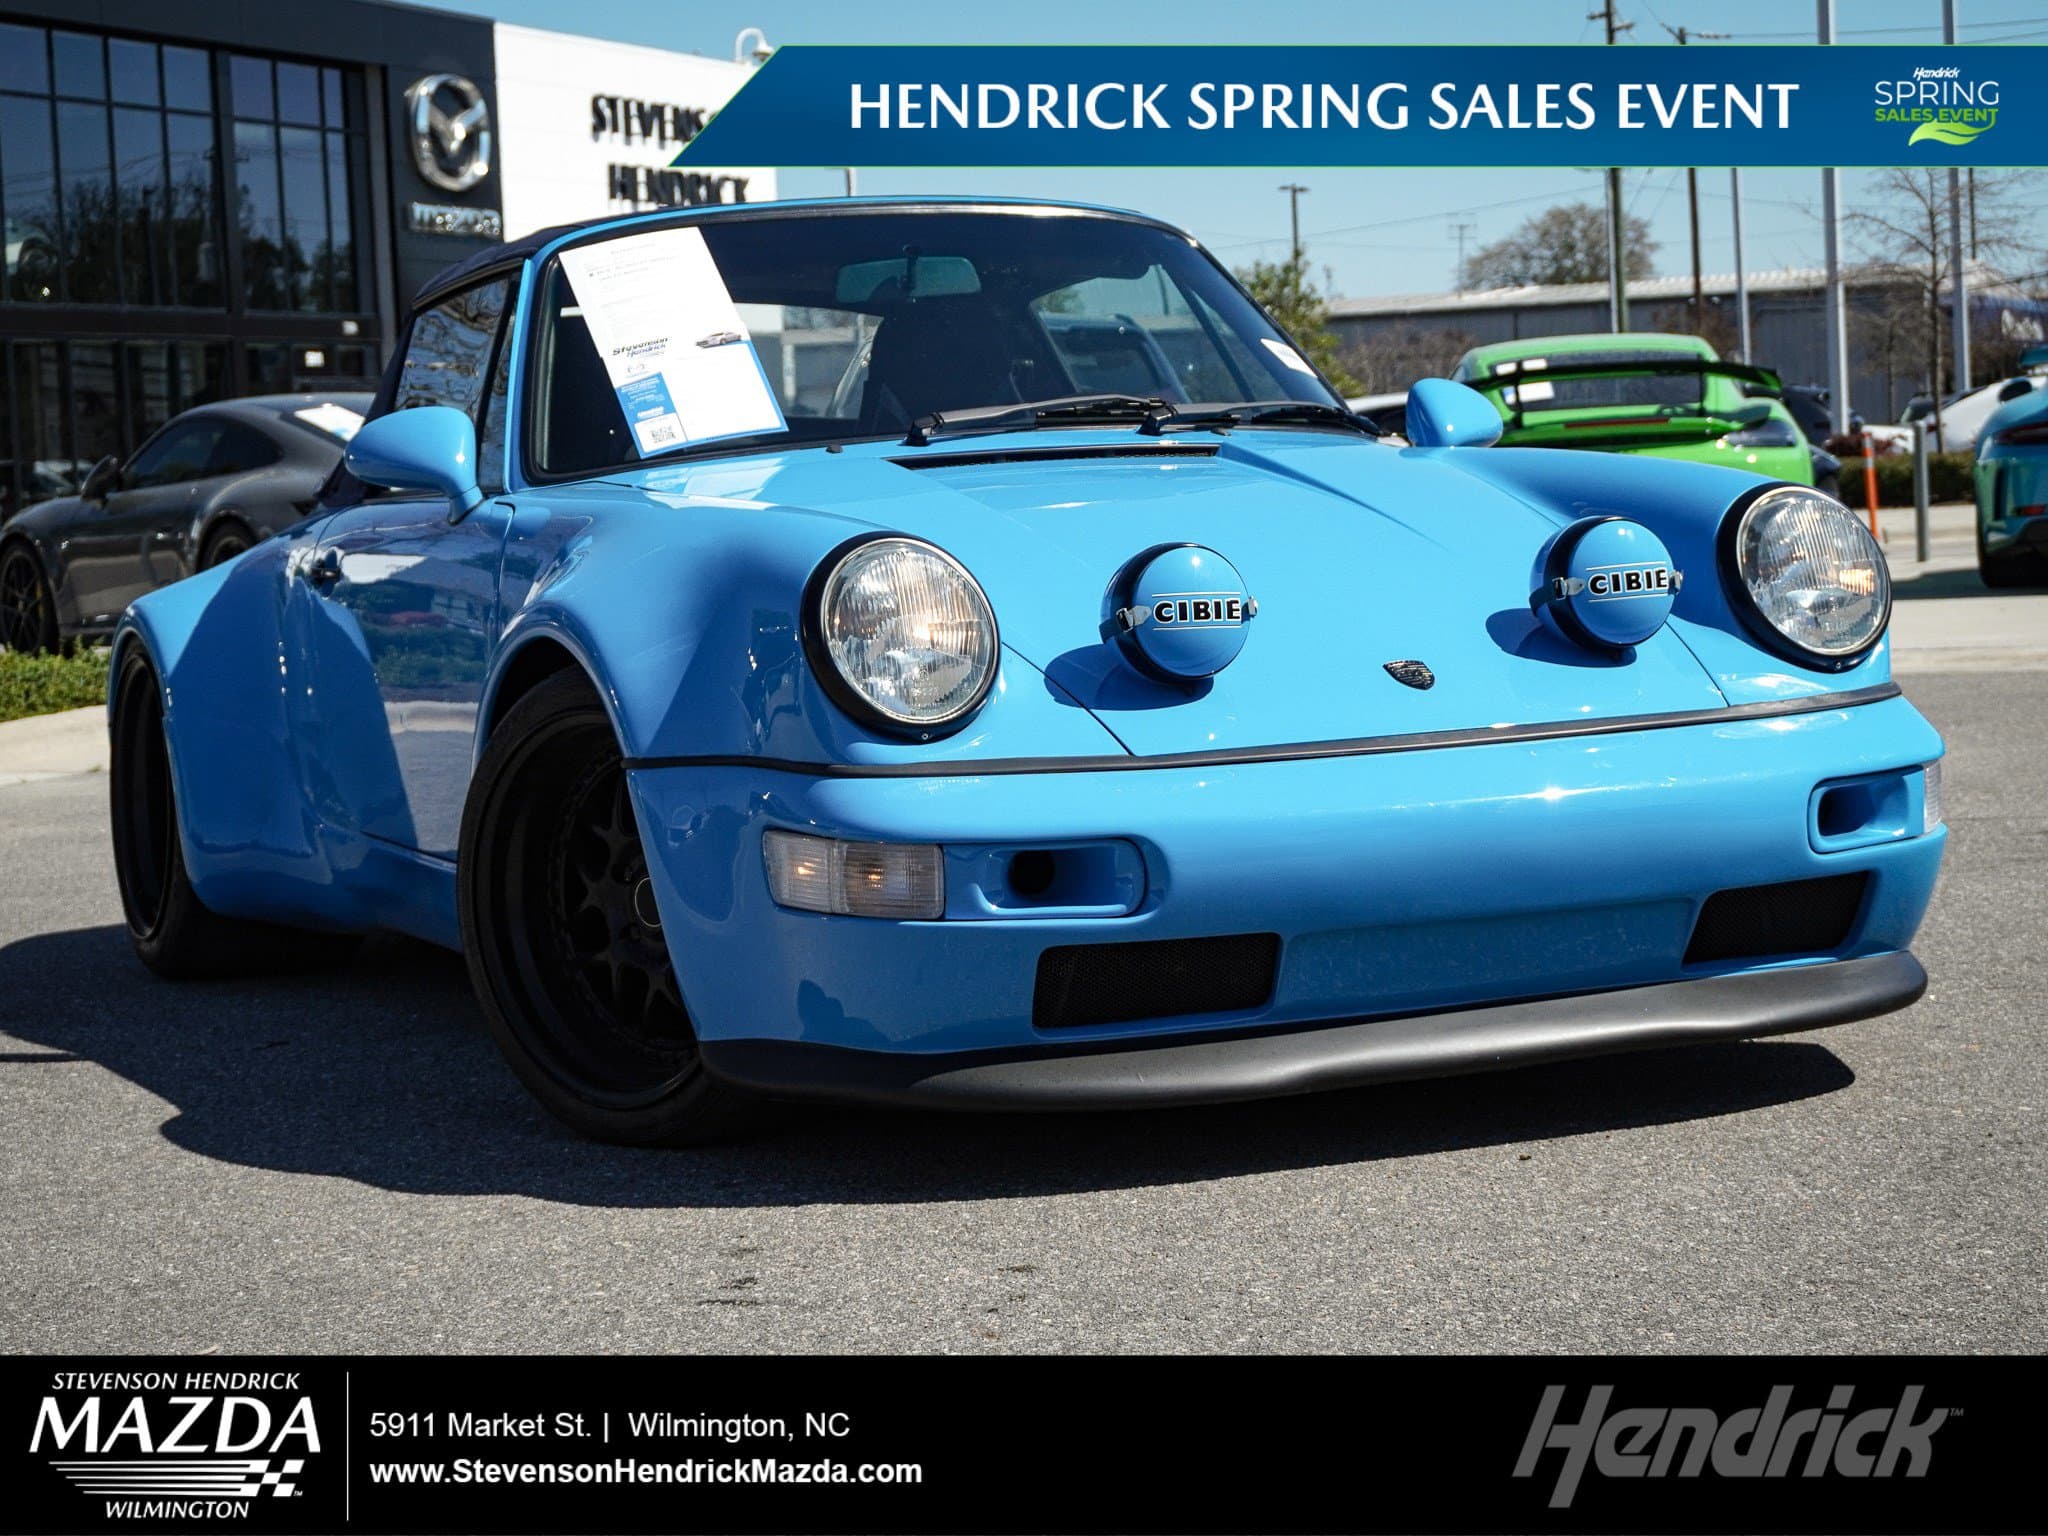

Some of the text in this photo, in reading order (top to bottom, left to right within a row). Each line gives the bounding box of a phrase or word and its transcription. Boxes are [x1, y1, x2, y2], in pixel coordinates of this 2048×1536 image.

[591, 94, 720, 144] STEVENS
[1588, 566, 1669, 596] CIBIE
[1153, 597, 1242, 624] CIBIE
